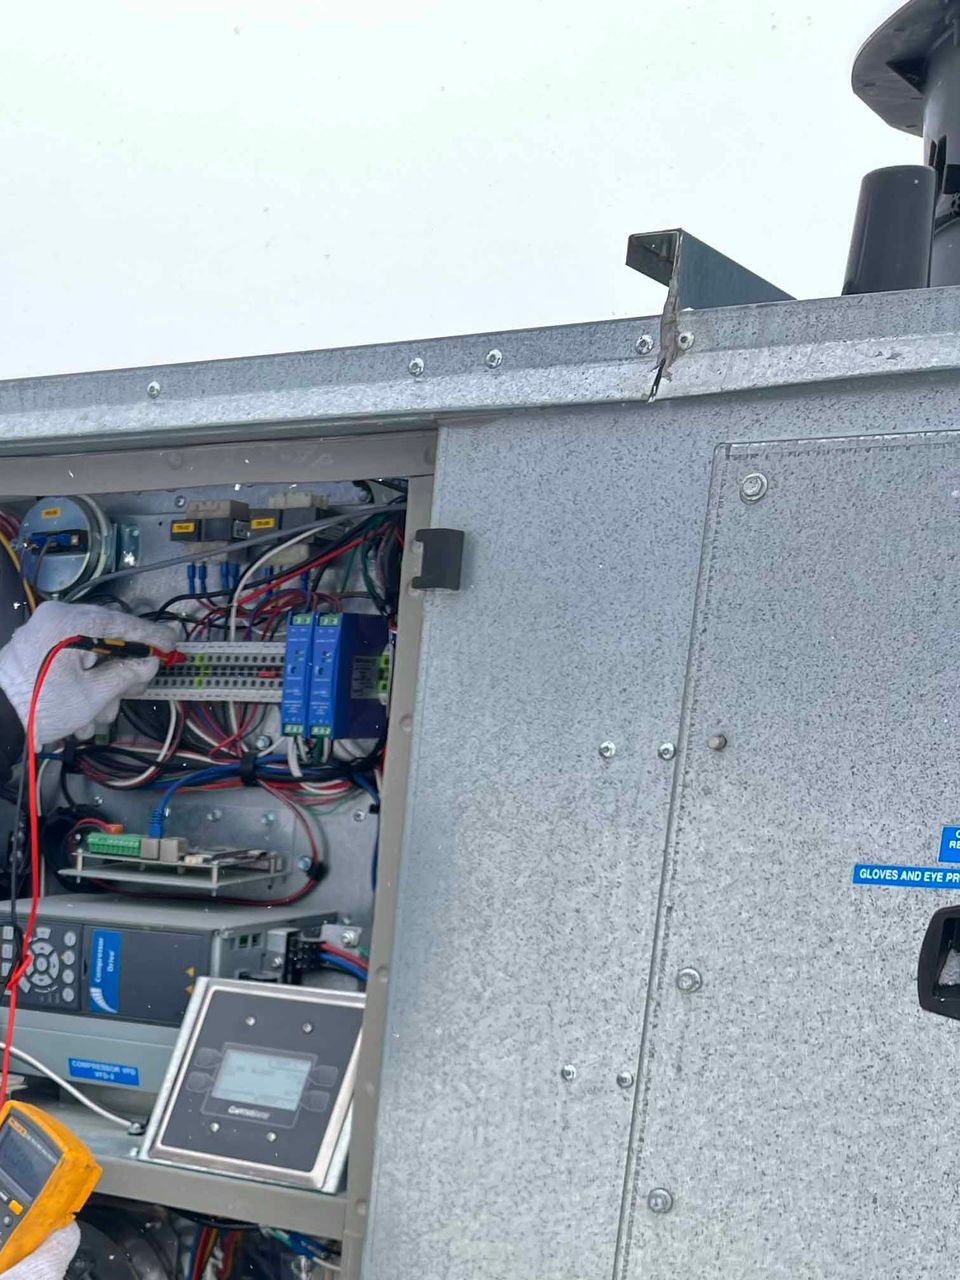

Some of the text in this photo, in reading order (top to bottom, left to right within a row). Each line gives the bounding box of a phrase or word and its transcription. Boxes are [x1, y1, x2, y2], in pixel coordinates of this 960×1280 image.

[859, 868, 898, 880] GLOVES
[900, 870, 922, 881] AND
[924, 871, 944, 883] EYE
[95, 937, 115, 983] Compressor Drive
[71, 1060, 121, 1072] COMPRESSOR
